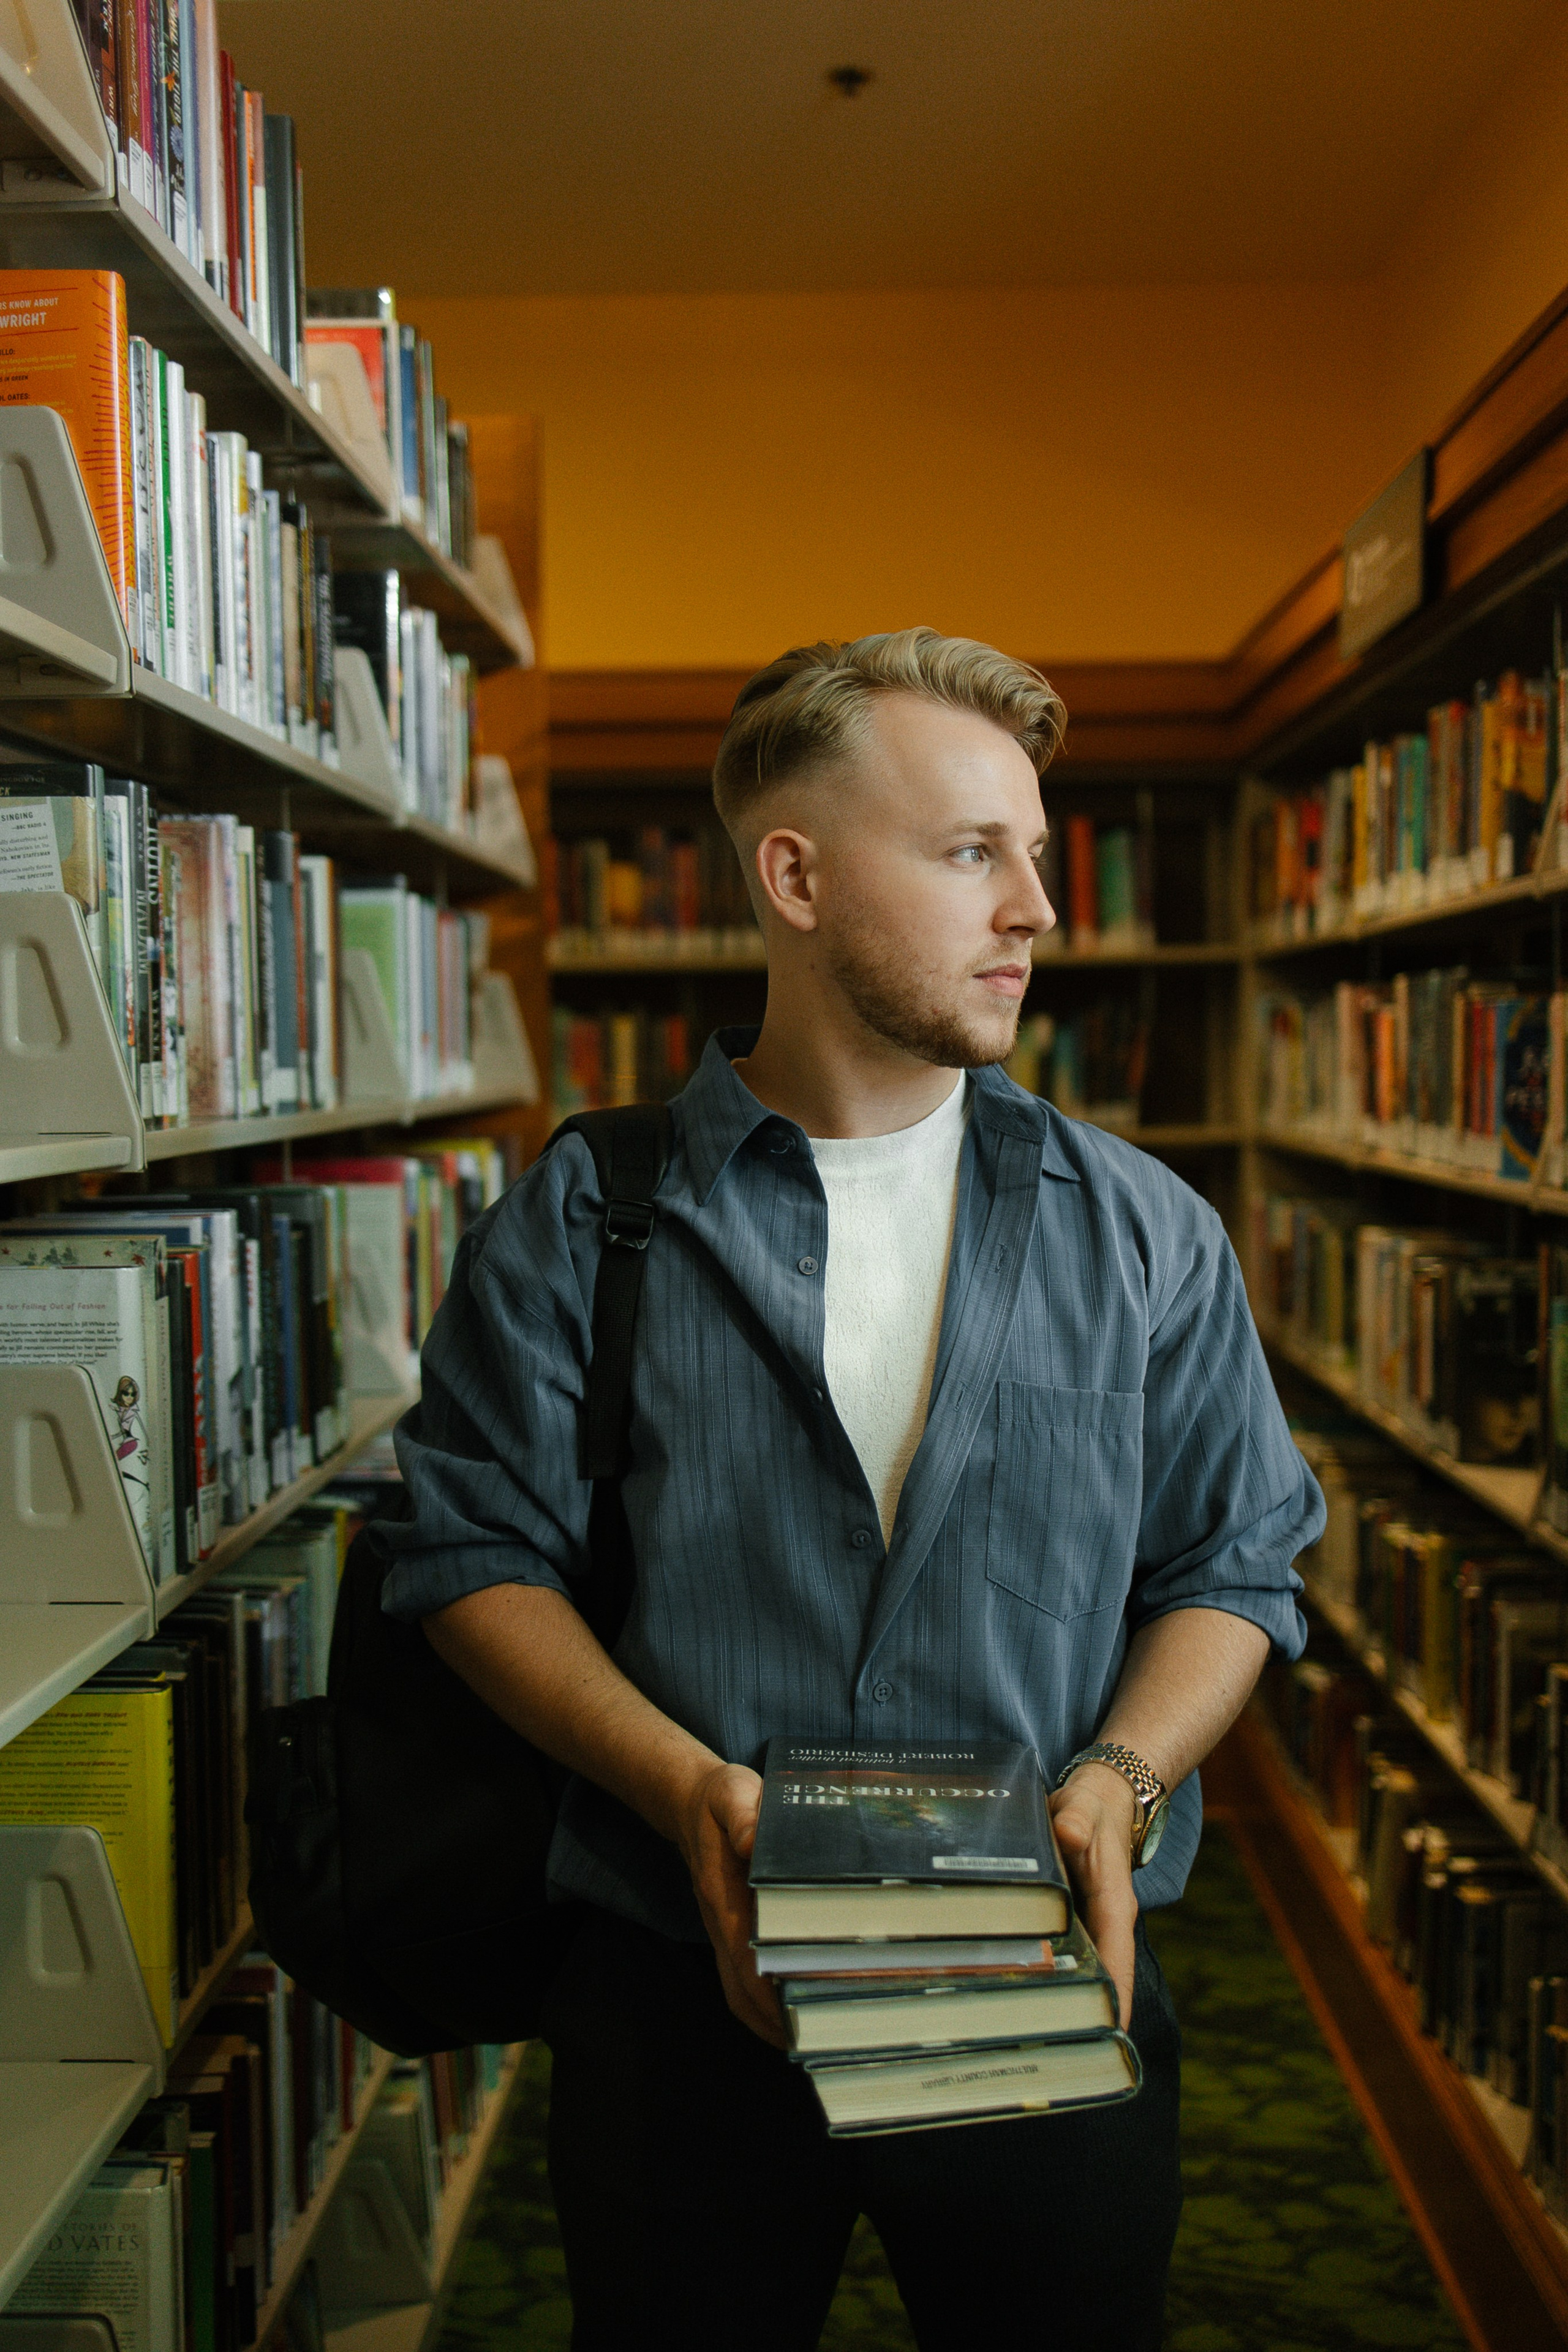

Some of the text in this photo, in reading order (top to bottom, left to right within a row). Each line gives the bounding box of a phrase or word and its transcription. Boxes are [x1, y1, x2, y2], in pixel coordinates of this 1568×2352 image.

[171, 48, 179, 77] THE
[173, 82, 183, 124] TIGER
[9, 300, 31, 309] KNOW
[34, 297, 59, 307] ABOUT
[0, 311, 47, 329] WRIGHT
[7, 393, 31, 401] OATES:
[1, 812, 34, 822] SINGING
[9, 835, 37, 845] disturbing
[23, 851, 51, 859] STATESMAN
[28, 871, 54, 880] SPECTATOR
[135, 888, 151, 974] MADAM
[21, 1303, 47, 1311] Falling
[67, 1302, 74, 1311] of
[788, 1754, 837, 1764] thriller
[790, 1748, 893, 1759] DESIDERIO
[838, 1757, 894, 1766] political
[783, 1784, 1011, 1798] OCCURRENCE
[783, 1794, 850, 1806] THE
[921, 2075, 954, 2090] LIBRARY
[955, 2070, 988, 2084] COUNTY
[122, 2222, 137, 2231] OF
[48, 2235, 63, 2252] D
